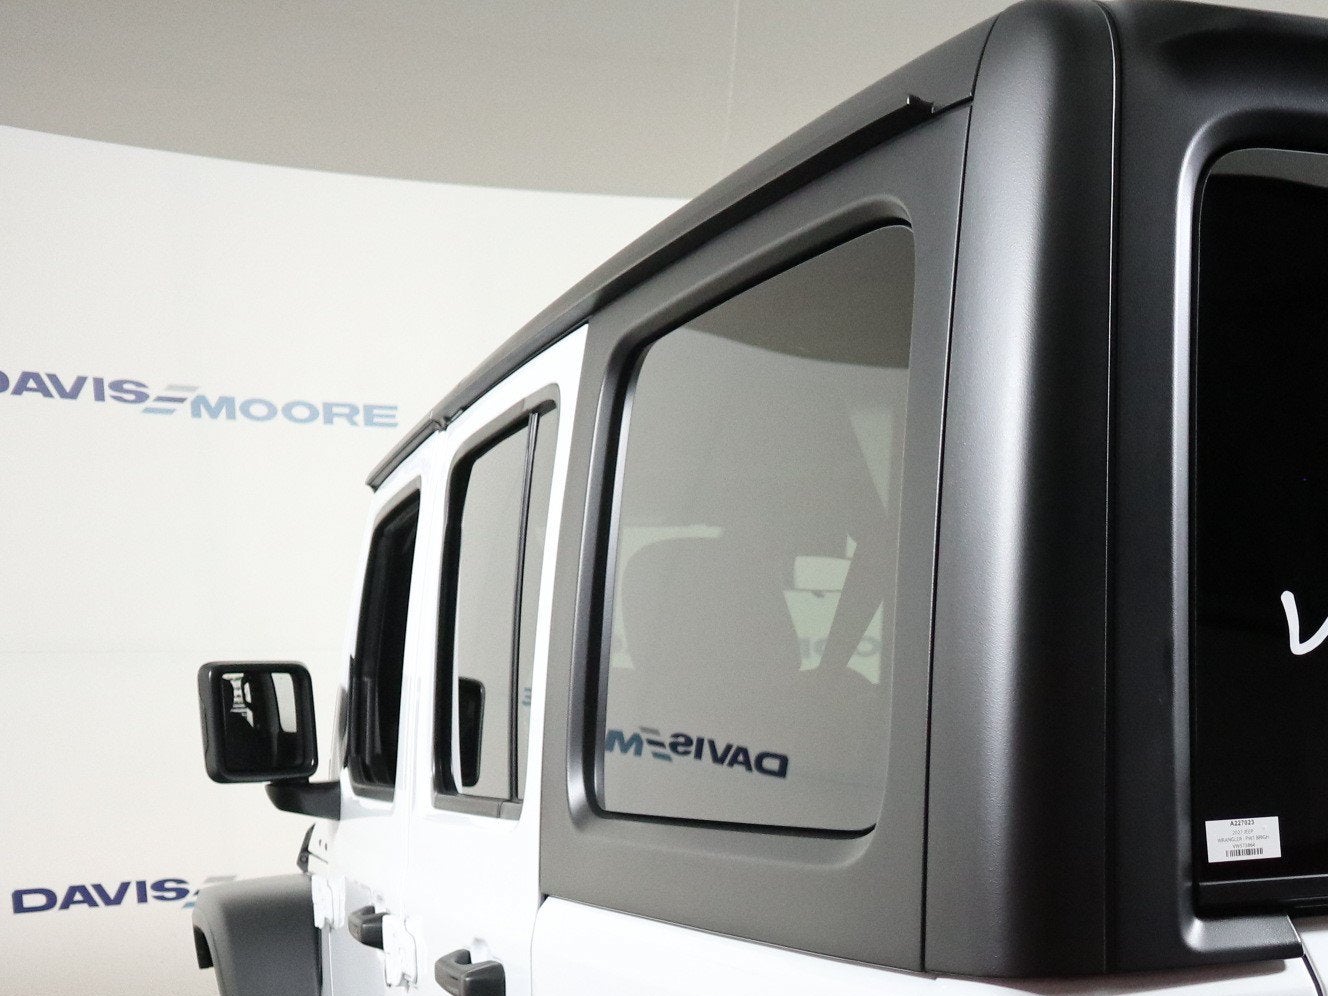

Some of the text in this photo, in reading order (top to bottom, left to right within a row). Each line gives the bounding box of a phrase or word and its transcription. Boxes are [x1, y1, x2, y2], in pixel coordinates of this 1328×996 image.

[0, 370, 399, 427] AVIS MOORE
[11, 878, 189, 914] DAVIS
